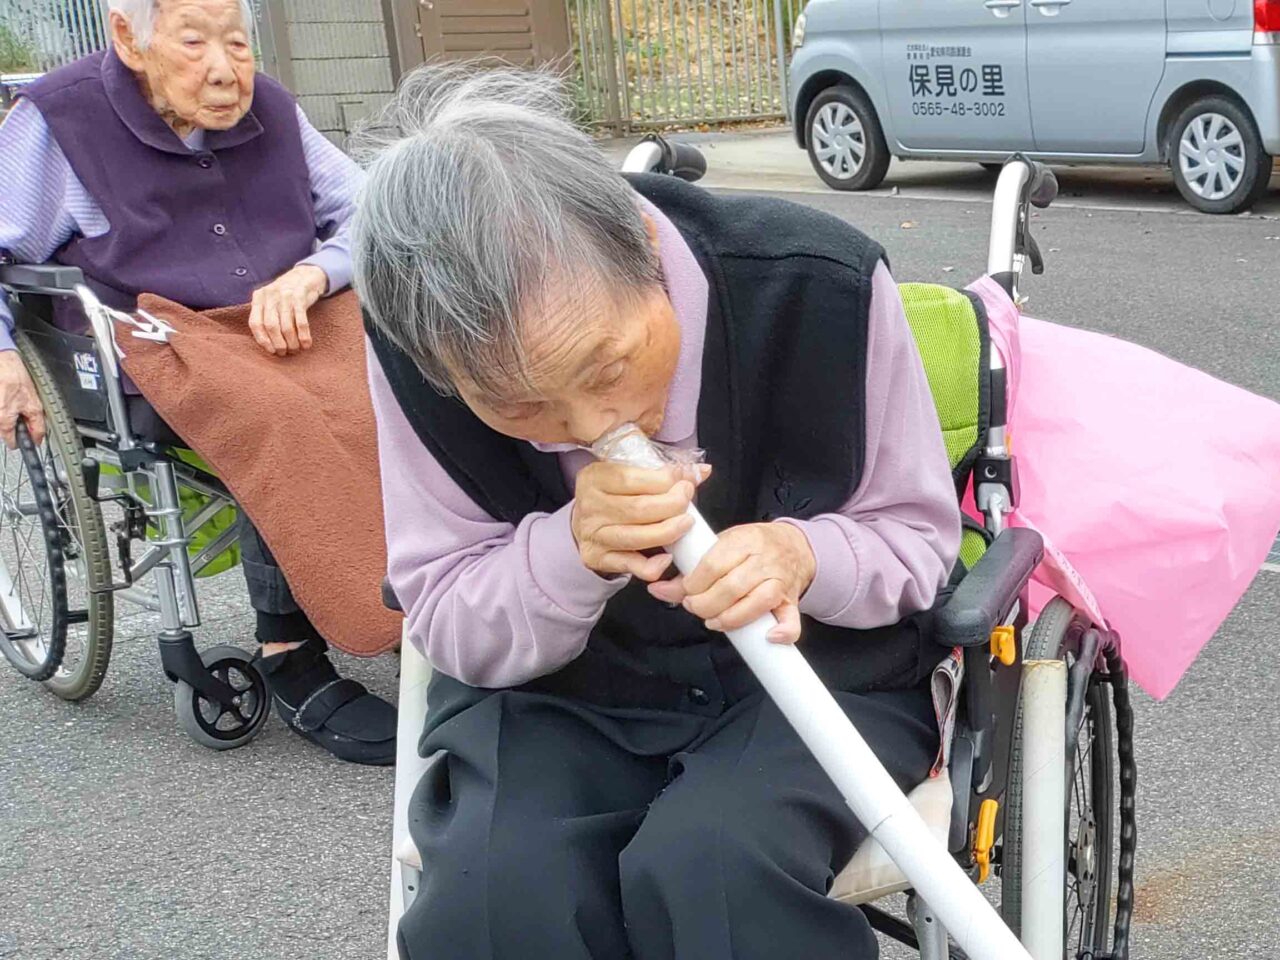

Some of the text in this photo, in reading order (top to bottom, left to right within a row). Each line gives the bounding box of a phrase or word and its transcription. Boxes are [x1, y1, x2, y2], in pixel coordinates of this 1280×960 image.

[909, 64, 1006, 98] 保見の里
[912, 102, 1006, 117] 0565-48-3002
